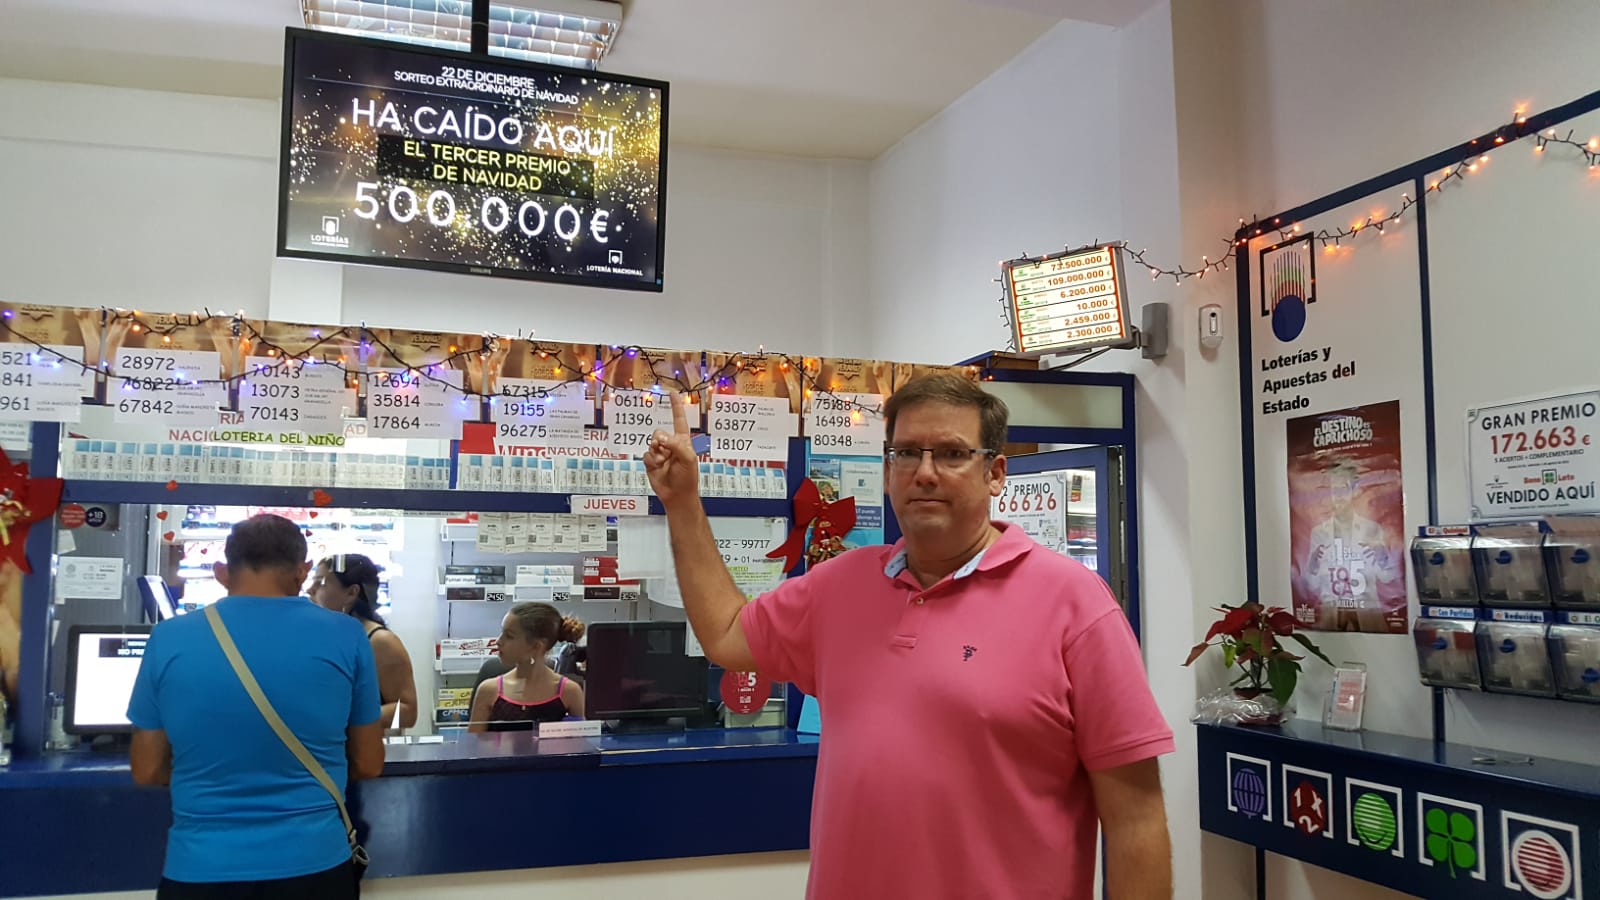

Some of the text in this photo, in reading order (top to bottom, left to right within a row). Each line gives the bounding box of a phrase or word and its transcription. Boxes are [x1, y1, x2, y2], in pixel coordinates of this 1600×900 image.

[441, 66, 535, 89] 22 DE DICIEMBRE
[394, 71, 579, 105] SORTEO EXTRAORDINARIO DE NAVIDAD
[352, 98, 615, 159] HA CAÍDO AQUÍ
[404, 140, 571, 176] EL TERCER PREMIO
[433, 165, 542, 192] DE NAVIDAD
[1051, 256, 1102, 272] 73.500.000
[1048, 269, 1104, 286] 109.000.000
[1060, 284, 1106, 299] 6.200.000
[1077, 299, 1108, 310] 10.000
[1064, 312, 1110, 327] 2.459.000
[1067, 325, 1113, 338] 2.300.000
[122, 355, 175, 370] 28972
[1261, 346, 1331, 371] Loterías y
[252, 364, 300, 379] 70143
[1262, 361, 1356, 394] Apuestas del
[251, 384, 299, 398] 13073
[120, 399, 173, 413] 67842
[373, 394, 420, 408] 35814
[614, 394, 653, 408] 06116
[715, 400, 756, 415] 93037
[815, 398, 851, 411] 75188
[1262, 395, 1310, 414] Estado
[250, 406, 299, 421] 70143
[503, 402, 545, 417] 19155
[1481, 402, 1596, 430] GRAN PREMIO
[373, 416, 420, 430] 17864
[615, 412, 653, 426] 11396
[714, 418, 756, 432] 63877
[815, 415, 851, 428] 16498
[1314, 427, 1321, 436] EL
[1321, 416, 1363, 433] DESTINO
[214, 431, 345, 446] LOTERIA DEL NIÑO
[500, 424, 546, 438] 96275
[1313, 428, 1373, 447] CAPRICHOSO
[716, 438, 753, 451] 18107
[814, 434, 852, 447] 80348
[1491, 426, 1591, 454] 172.663 €
[1499, 455, 1524, 463] ACIERTOS
[1529, 449, 1584, 460] COMPLEMENTARIO
[1014, 482, 1051, 497] PREMIO
[1487, 481, 1596, 504] VENDIDO AQUÍ
[583, 499, 636, 510] JUEVES
[998, 493, 1057, 512] 66626
[741, 540, 770, 549] 99717
[1298, 815, 1320, 833] 2
